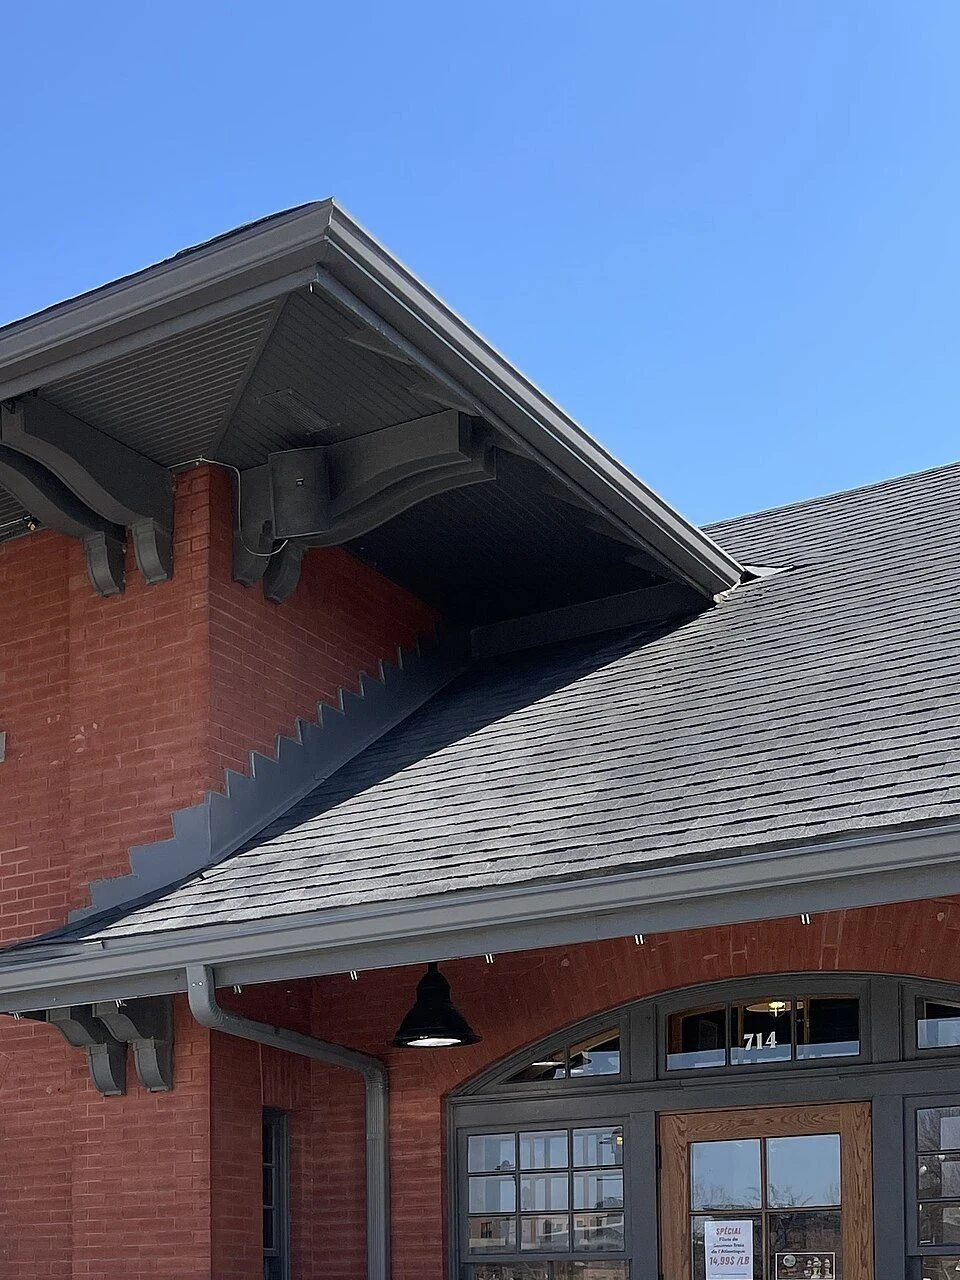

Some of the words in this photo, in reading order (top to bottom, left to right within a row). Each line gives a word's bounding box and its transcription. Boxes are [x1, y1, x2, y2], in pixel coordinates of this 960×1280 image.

[743, 1031, 778, 1051] 714
[716, 1226, 742, 1236] SPÉCIAL
[710, 1256, 736, 1267] 14,99$
[736, 1256, 750, 1266] /LB
